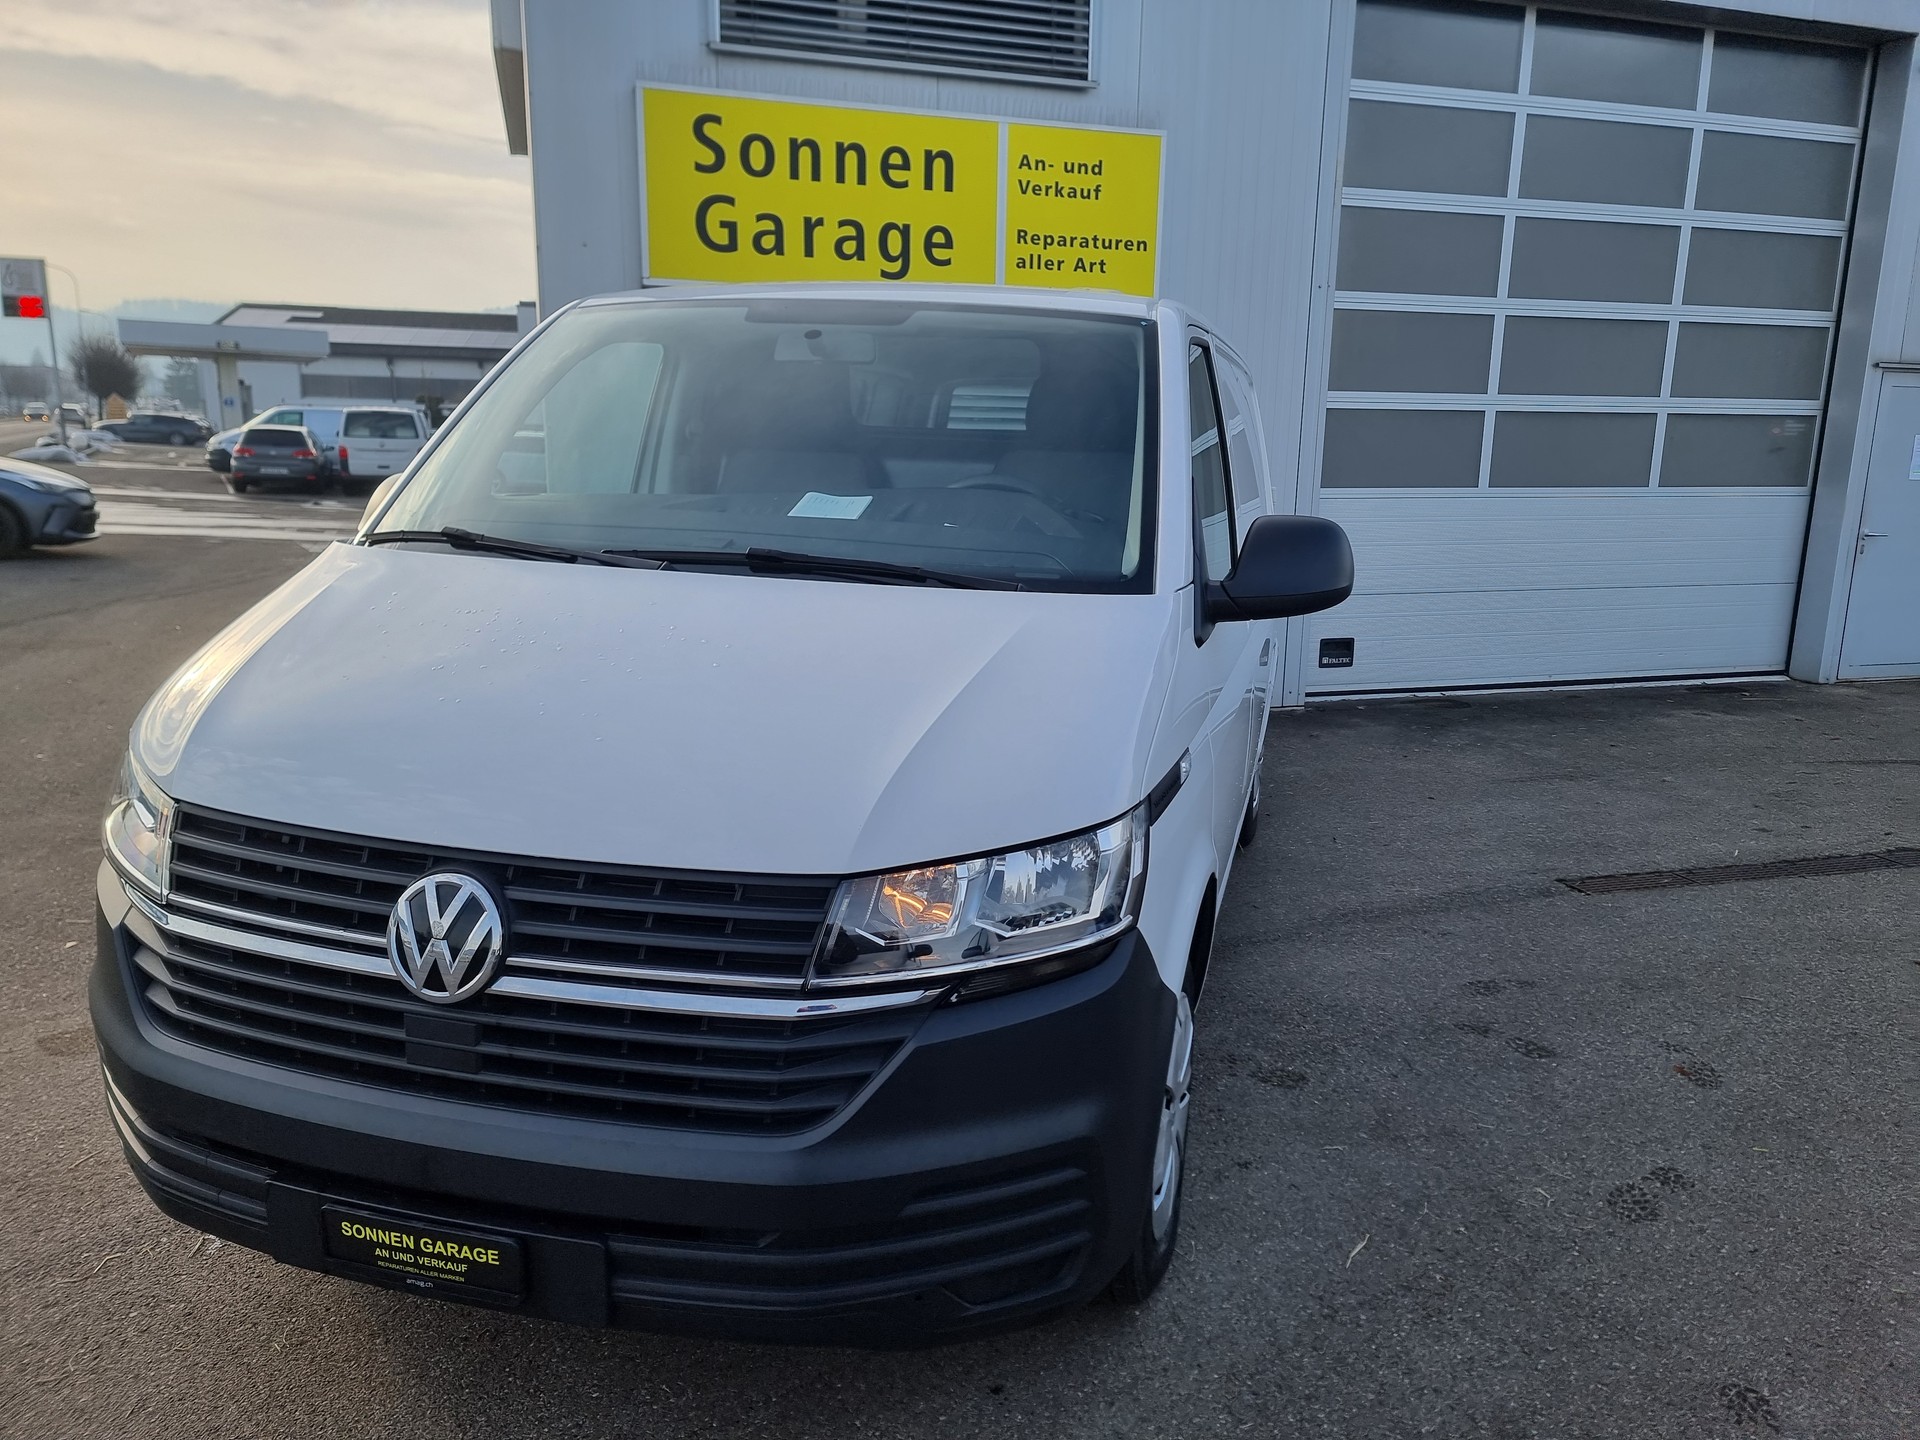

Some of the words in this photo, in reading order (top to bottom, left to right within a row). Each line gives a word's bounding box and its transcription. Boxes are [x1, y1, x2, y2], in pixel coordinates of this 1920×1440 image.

[692, 113, 955, 193] Sonnen
[1018, 154, 1054, 171] An-
[1063, 159, 1103, 176] und
[1017, 179, 1102, 200] Verkauf
[694, 194, 954, 281] Garage
[1016, 228, 1148, 252] Reparaturen
[1015, 253, 1065, 271] aller
[1073, 257, 1107, 274] Art
[386, 873, 503, 1004] VW
[341, 1221, 415, 1250] SONNEN
[419, 1238, 500, 1265] GARAGE
[374, 1248, 390, 1259] AN
[391, 1250, 415, 1263] UND
[416, 1255, 468, 1273] VERKAUF
[377, 1260, 420, 1274] REPARATUREN
[420, 1269, 439, 1278] ALLER
[439, 1272, 465, 1282] MARKEN
[405, 1278, 434, 1288] amag.ch
